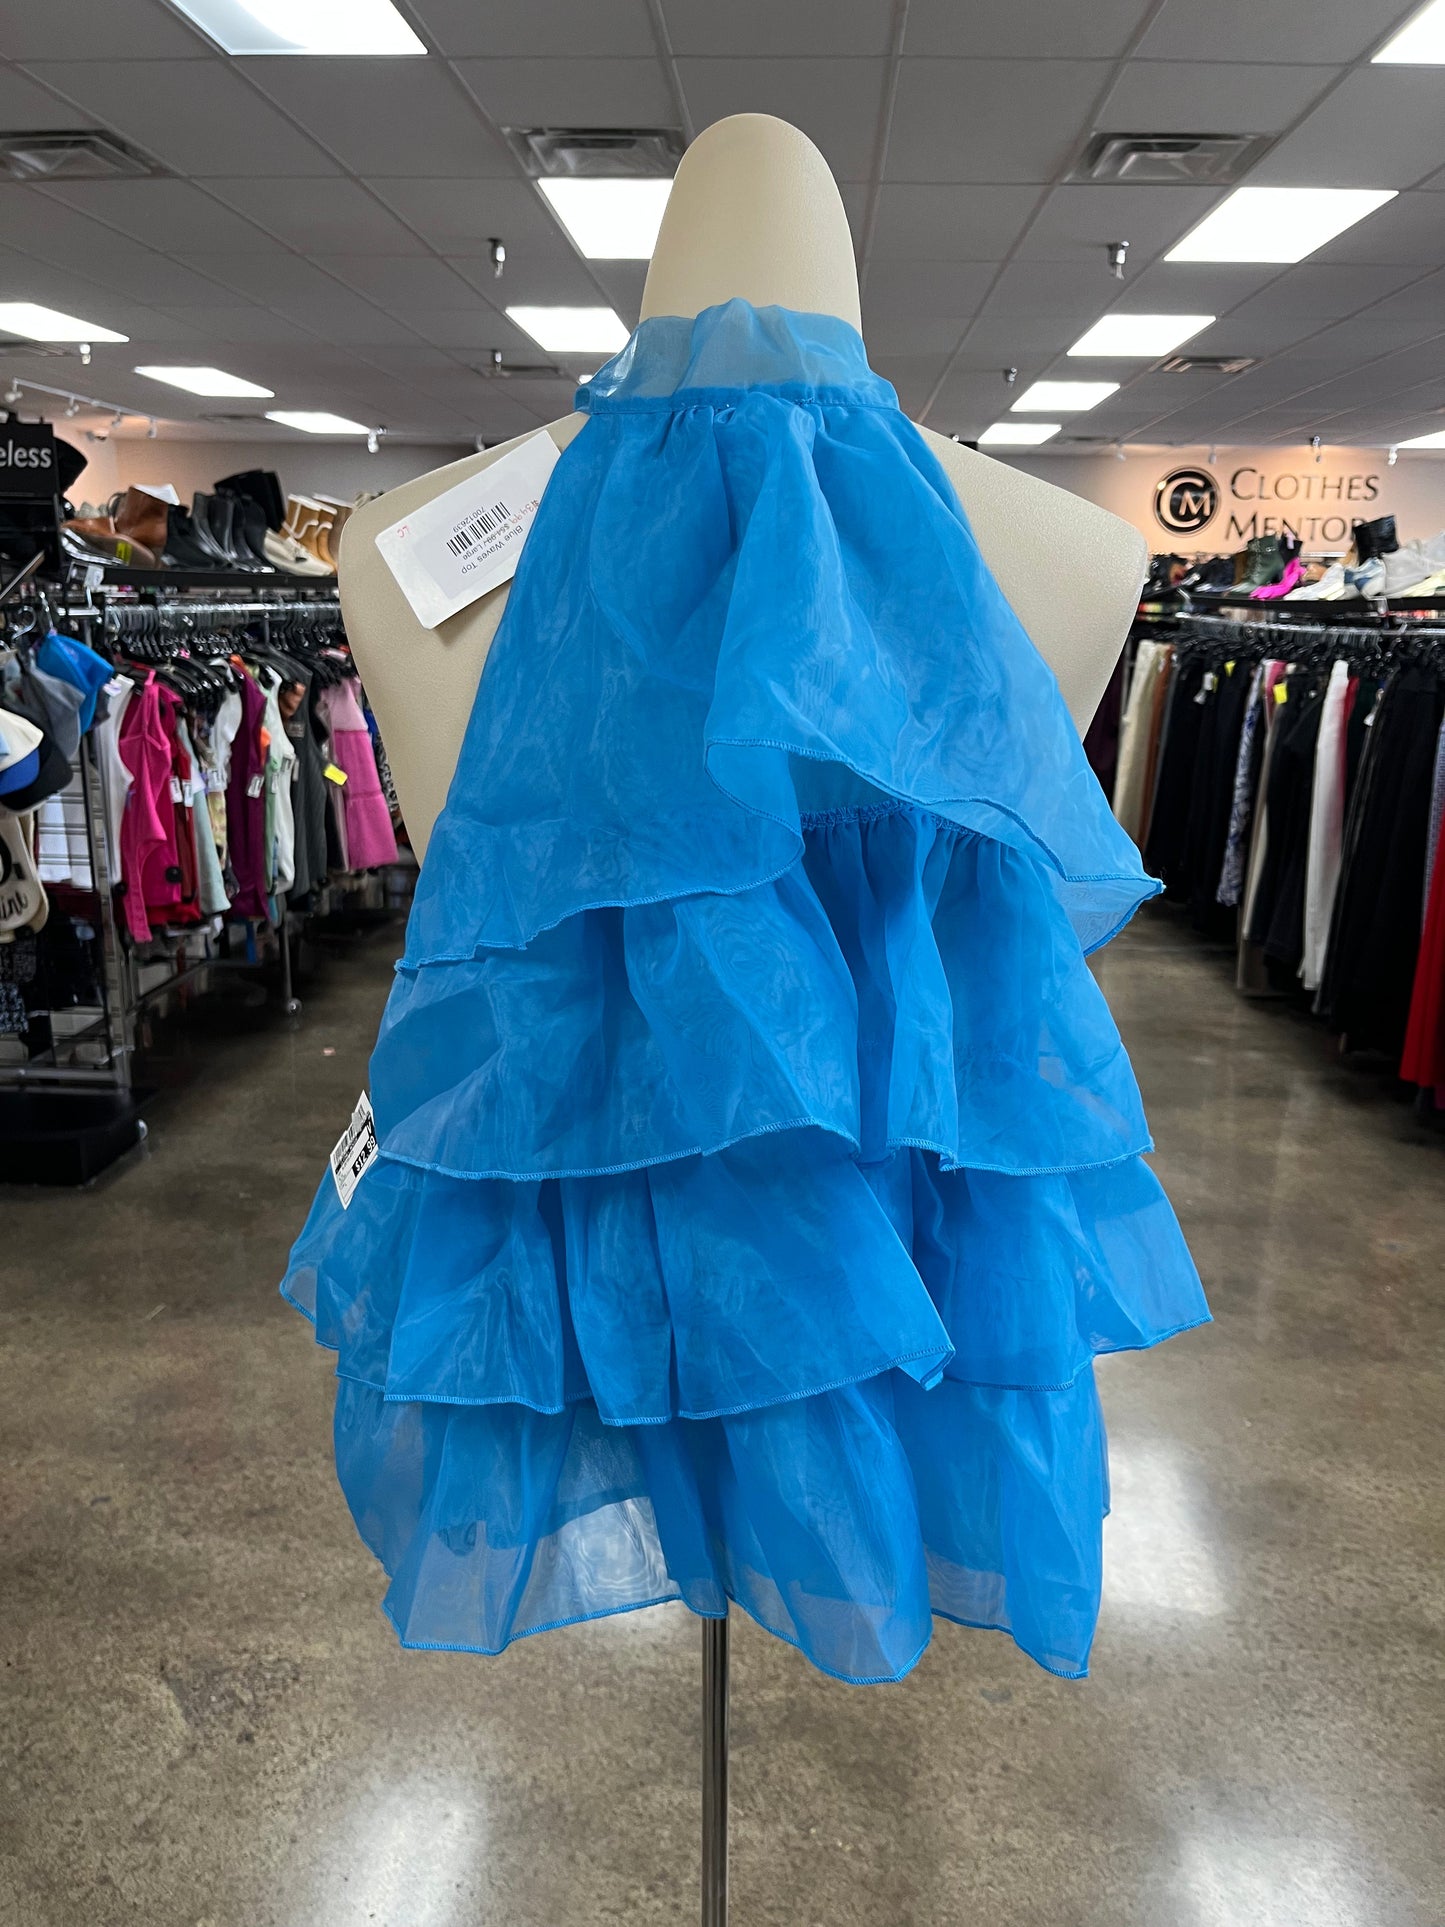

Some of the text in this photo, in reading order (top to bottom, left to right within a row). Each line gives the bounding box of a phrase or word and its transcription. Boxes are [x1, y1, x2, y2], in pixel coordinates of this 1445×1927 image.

[1230, 467, 1379, 501] CLOTHES
[461, 525, 524, 575] Blue Waves Top
[462, 543, 484, 561] Large
[355, 1135, 376, 1173] $12.99
